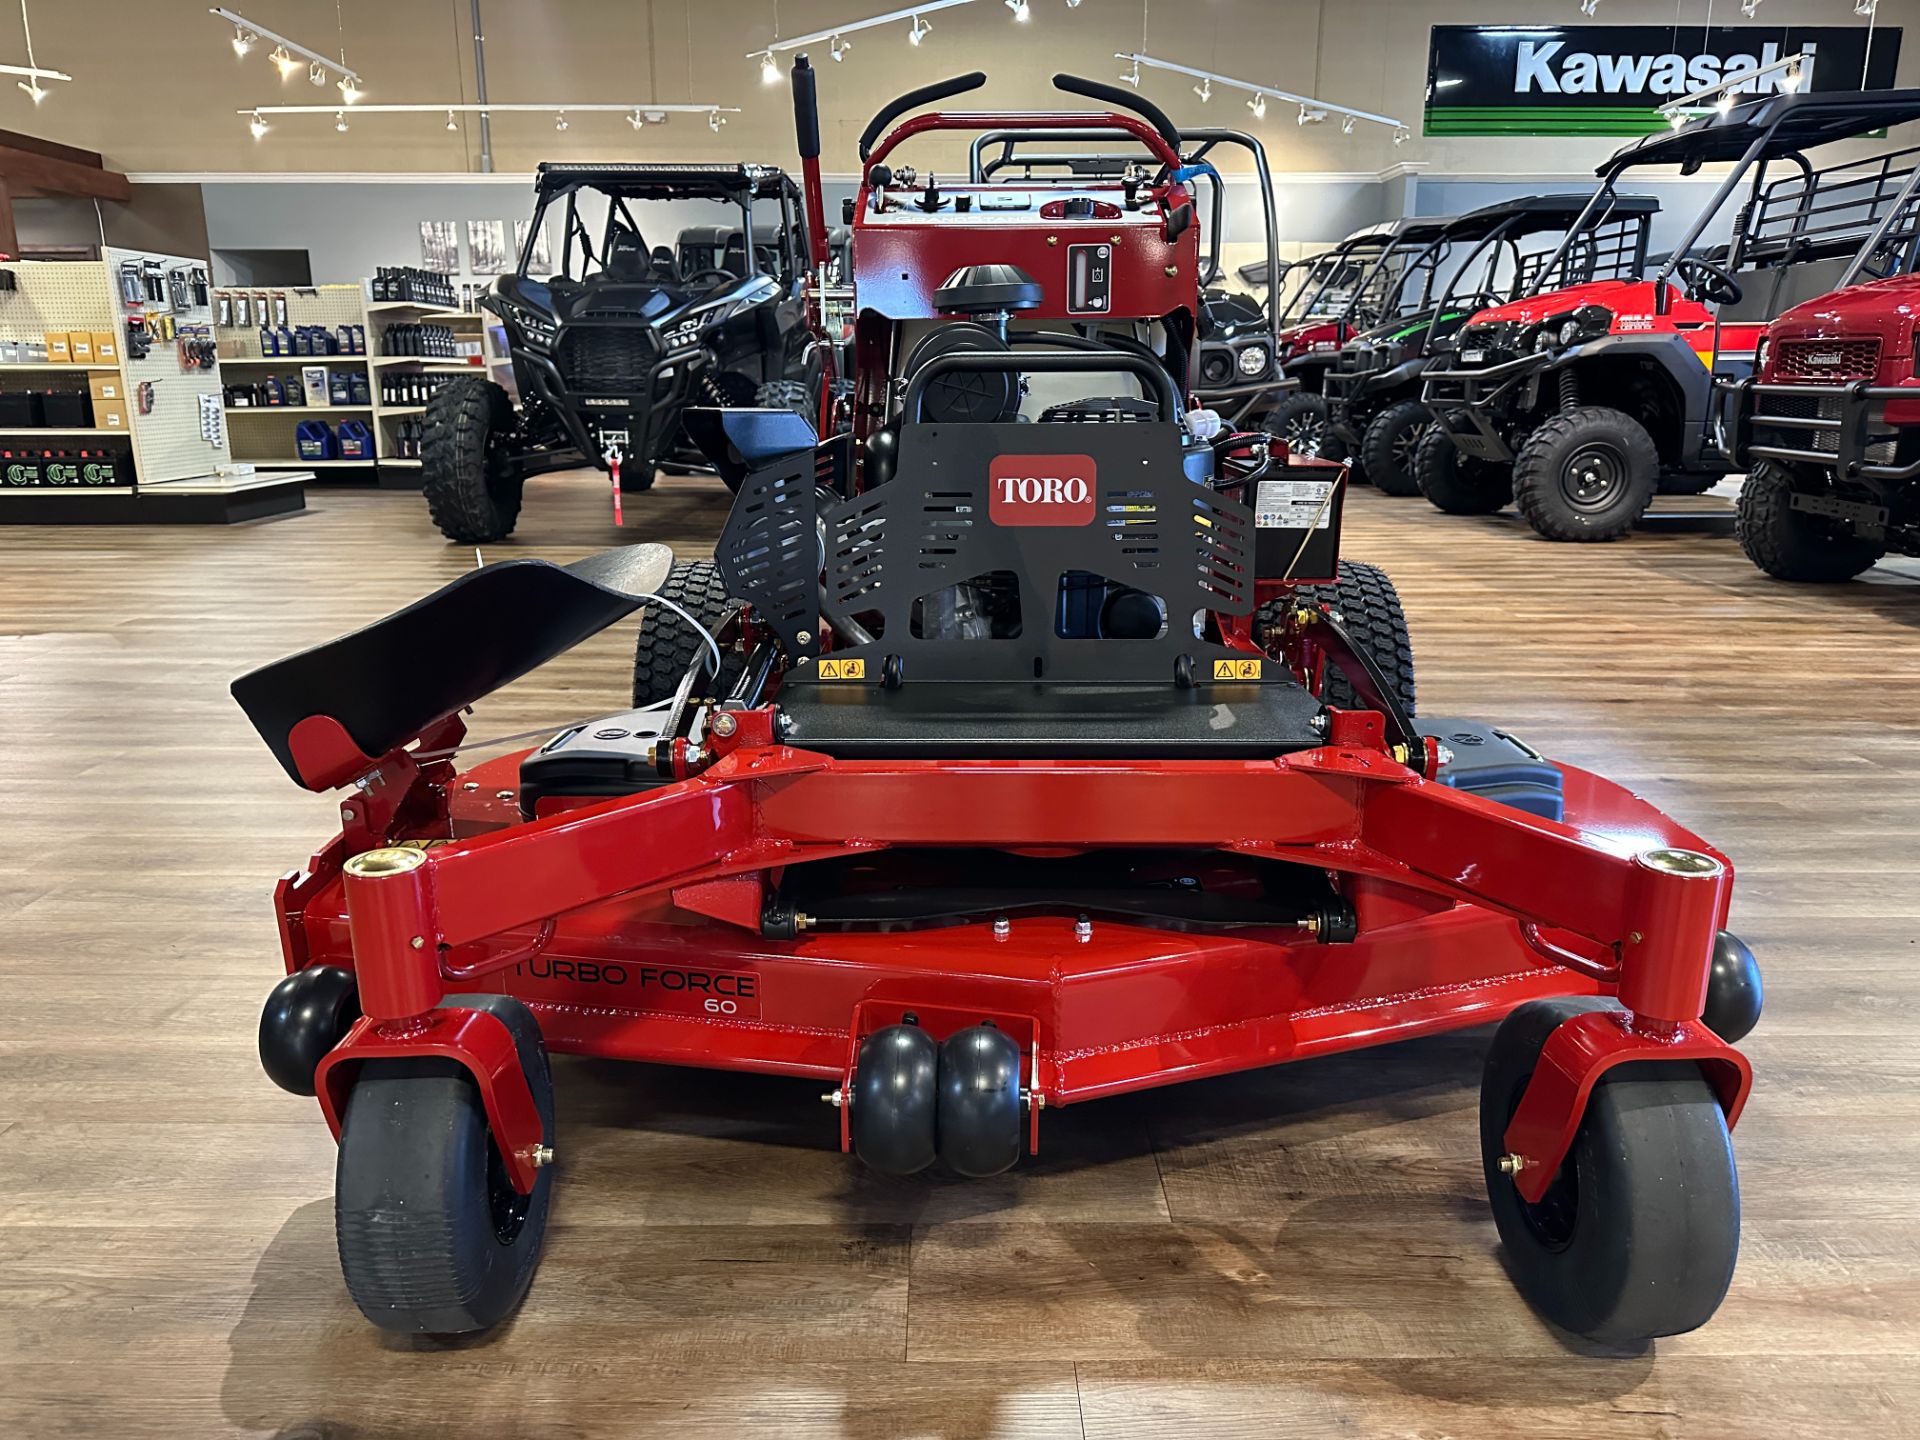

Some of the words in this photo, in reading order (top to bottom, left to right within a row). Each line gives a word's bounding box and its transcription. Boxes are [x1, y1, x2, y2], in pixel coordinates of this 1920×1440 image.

[1513, 40, 1818, 94] Kawasaki
[1807, 353, 1841, 365] Kawasaki
[997, 477, 1088, 504] TORO
[640, 967, 755, 998] FORCE
[703, 998, 737, 1014] 60
